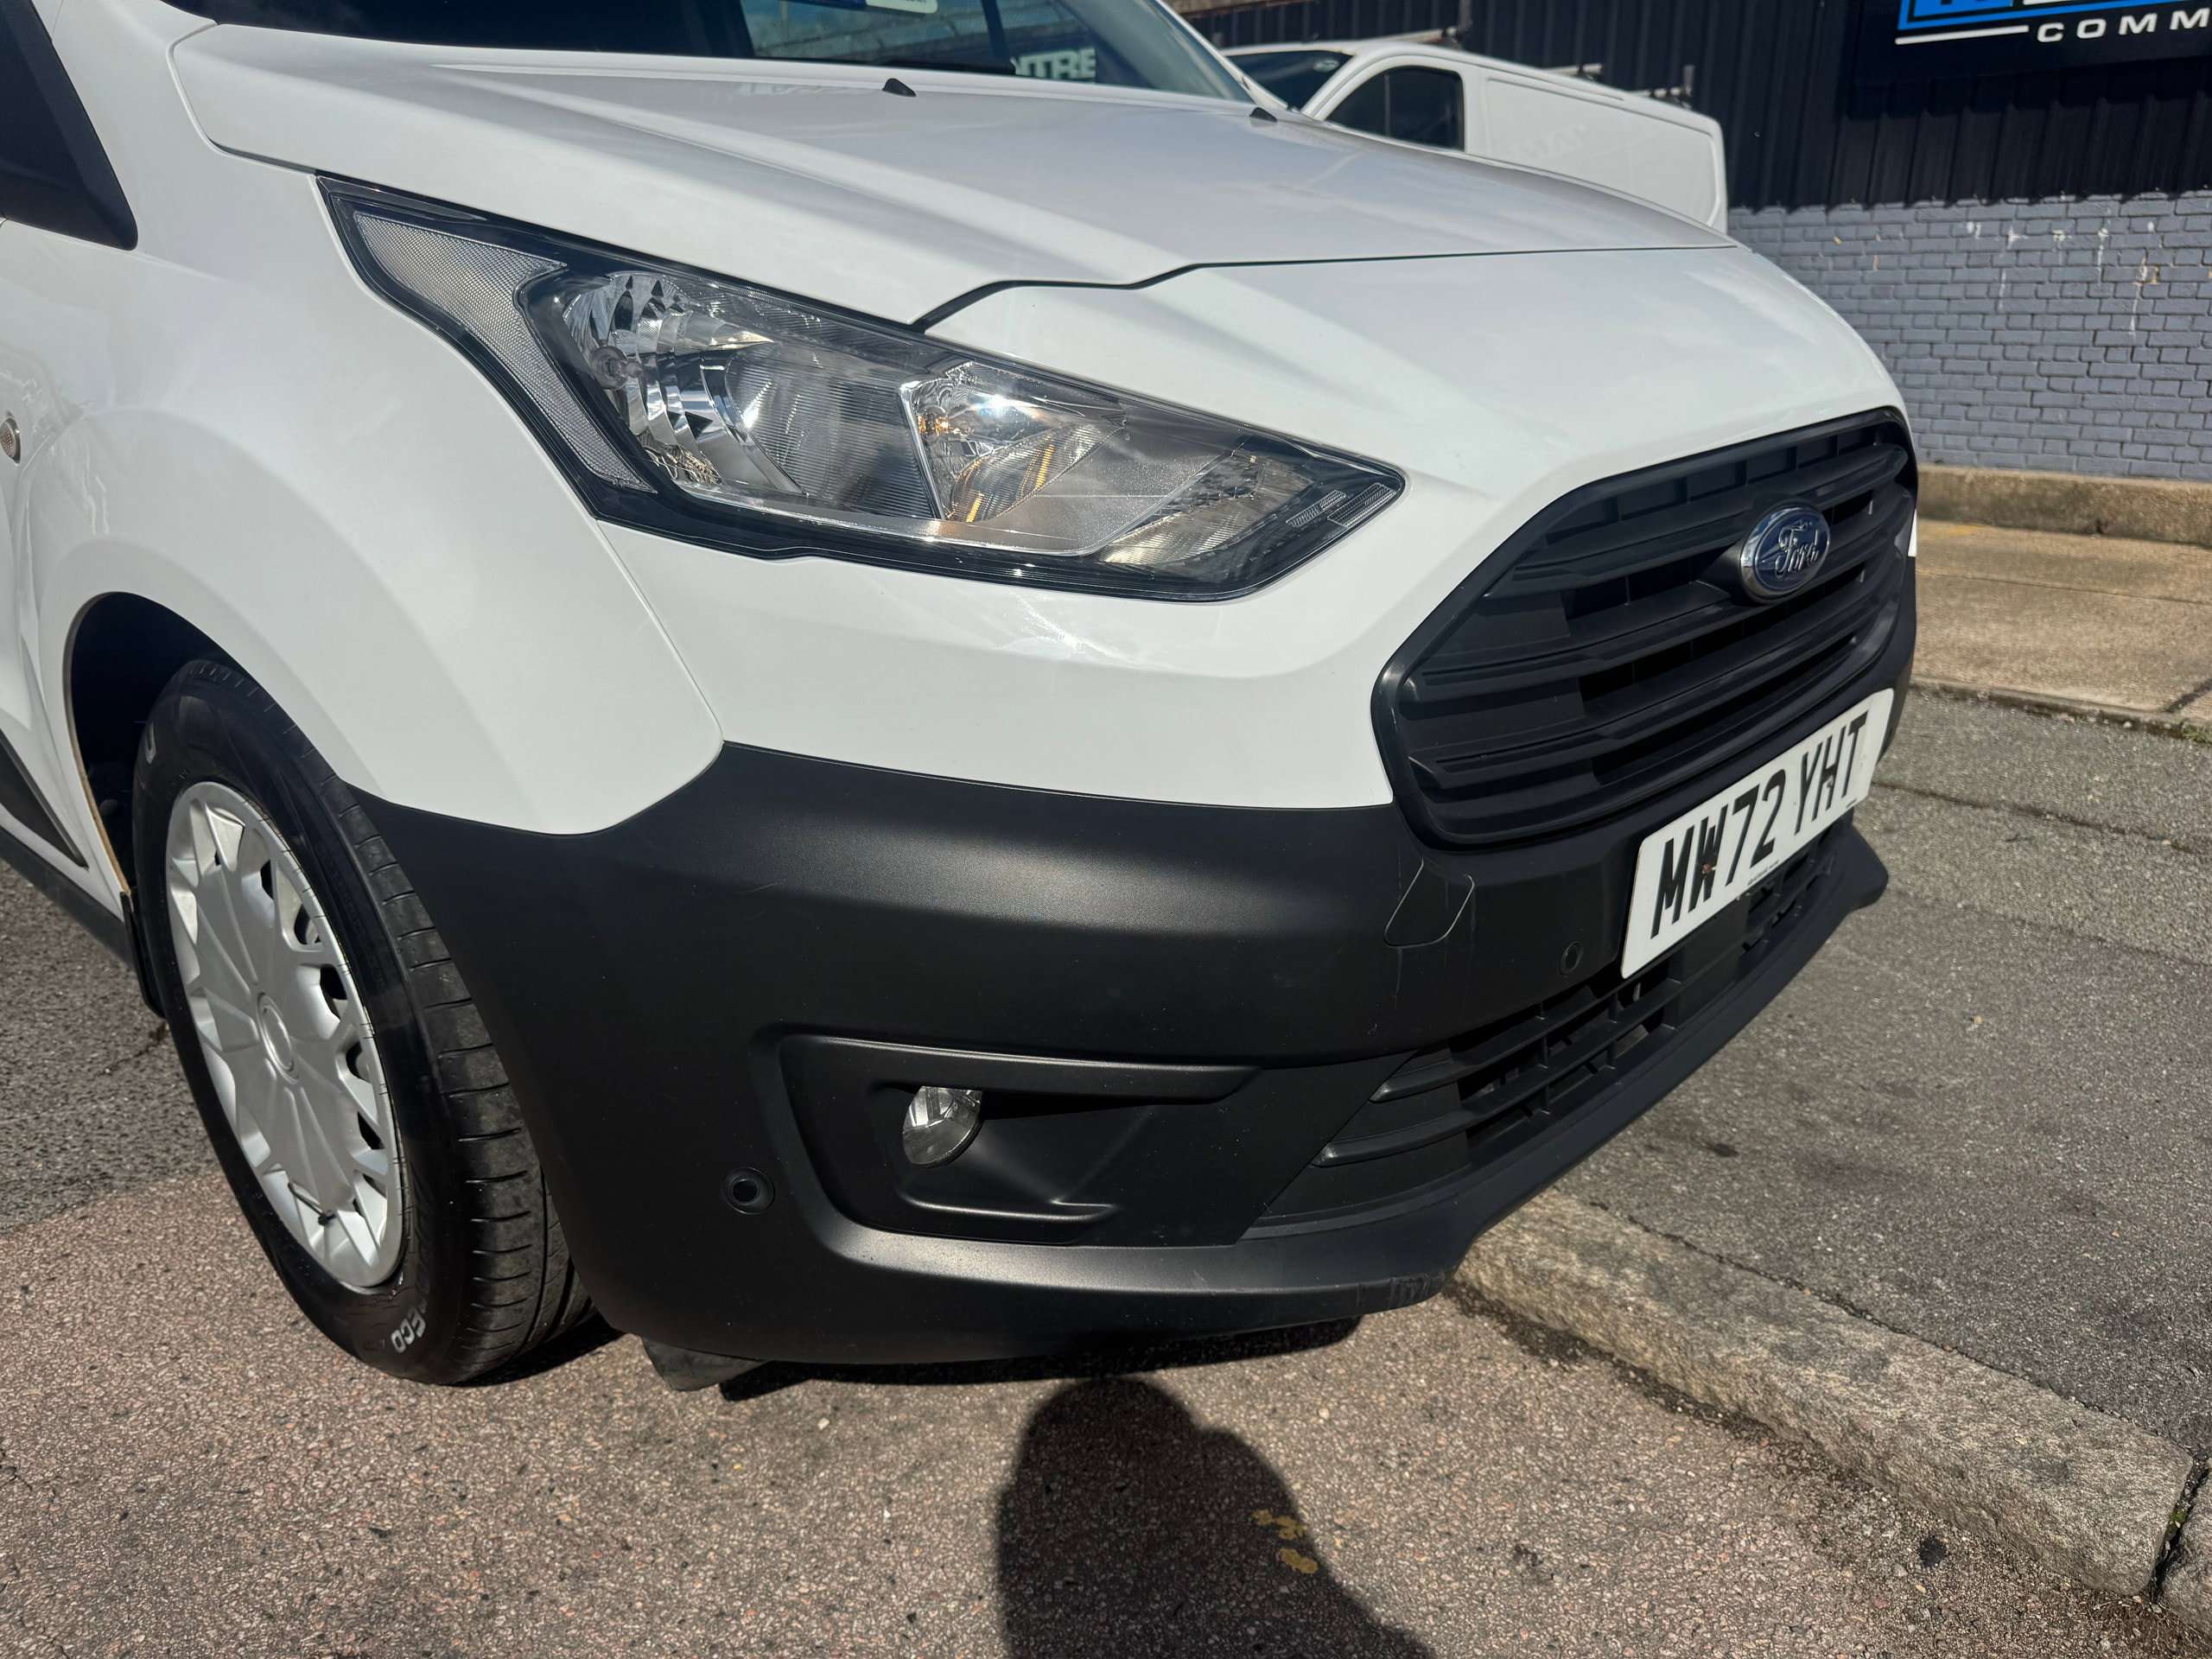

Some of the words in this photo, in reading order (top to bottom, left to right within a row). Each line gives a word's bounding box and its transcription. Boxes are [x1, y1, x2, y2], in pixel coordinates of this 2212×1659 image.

[2037, 8, 2211, 43] COMM
[1775, 518, 1820, 579] Ford
[1649, 768, 1787, 940] MW72
[1793, 709, 1870, 836] YHT
